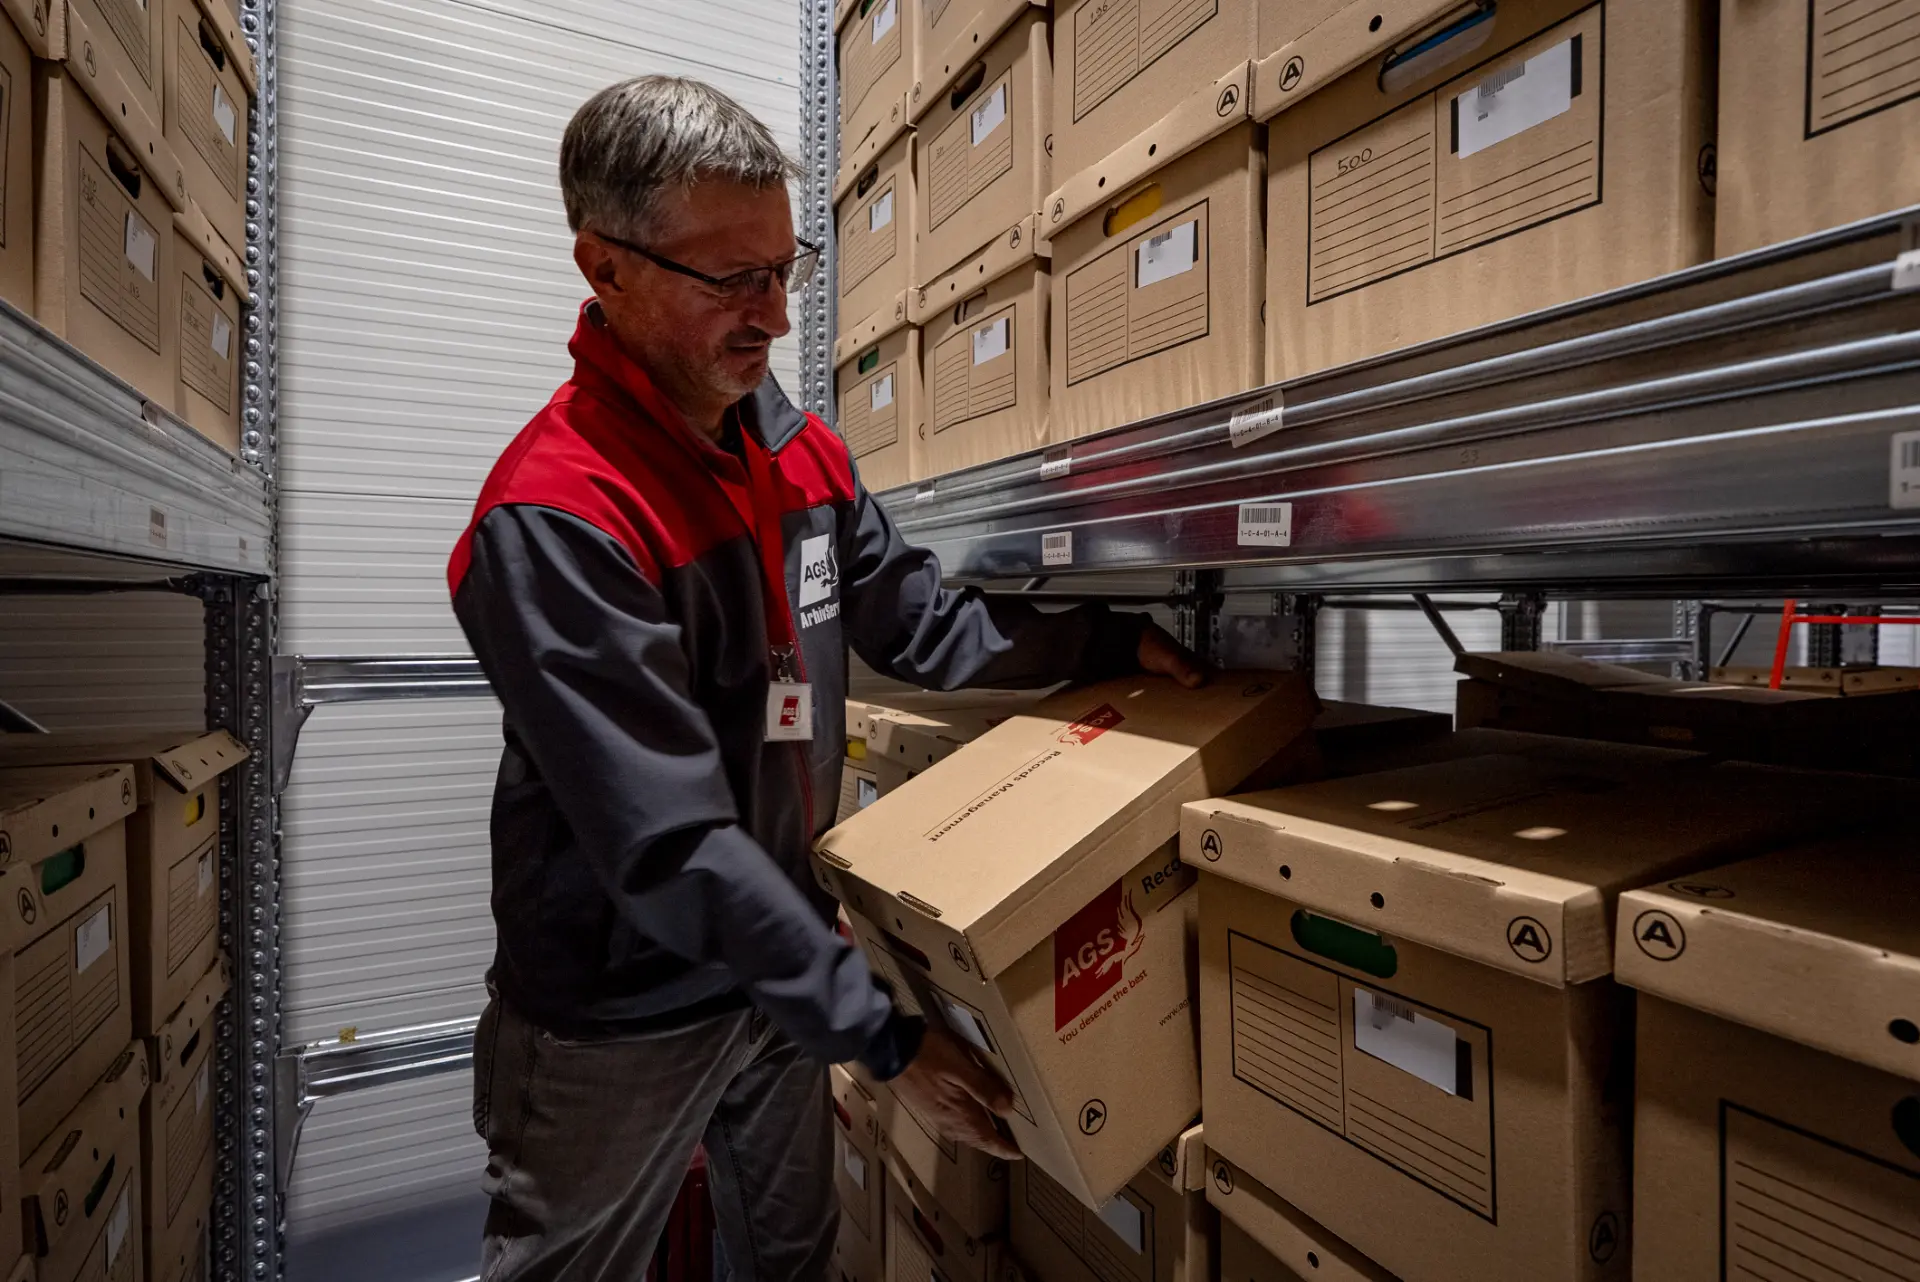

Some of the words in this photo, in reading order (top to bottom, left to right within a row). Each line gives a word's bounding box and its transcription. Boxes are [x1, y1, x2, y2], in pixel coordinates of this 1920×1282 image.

[1337, 147, 1373, 176] 500
[1240, 530, 1287, 538] 1-C-4-01-A-4
[804, 559, 827, 583] AGS
[1079, 711, 1113, 733] AGS
[1013, 750, 1062, 783] Records
[929, 782, 1014, 843] Management
[1062, 928, 1115, 989] AGS
[1058, 1028, 1079, 1046] You
[1079, 999, 1113, 1031] deserve
[1112, 985, 1129, 1003] the
[1129, 969, 1149, 989] best
